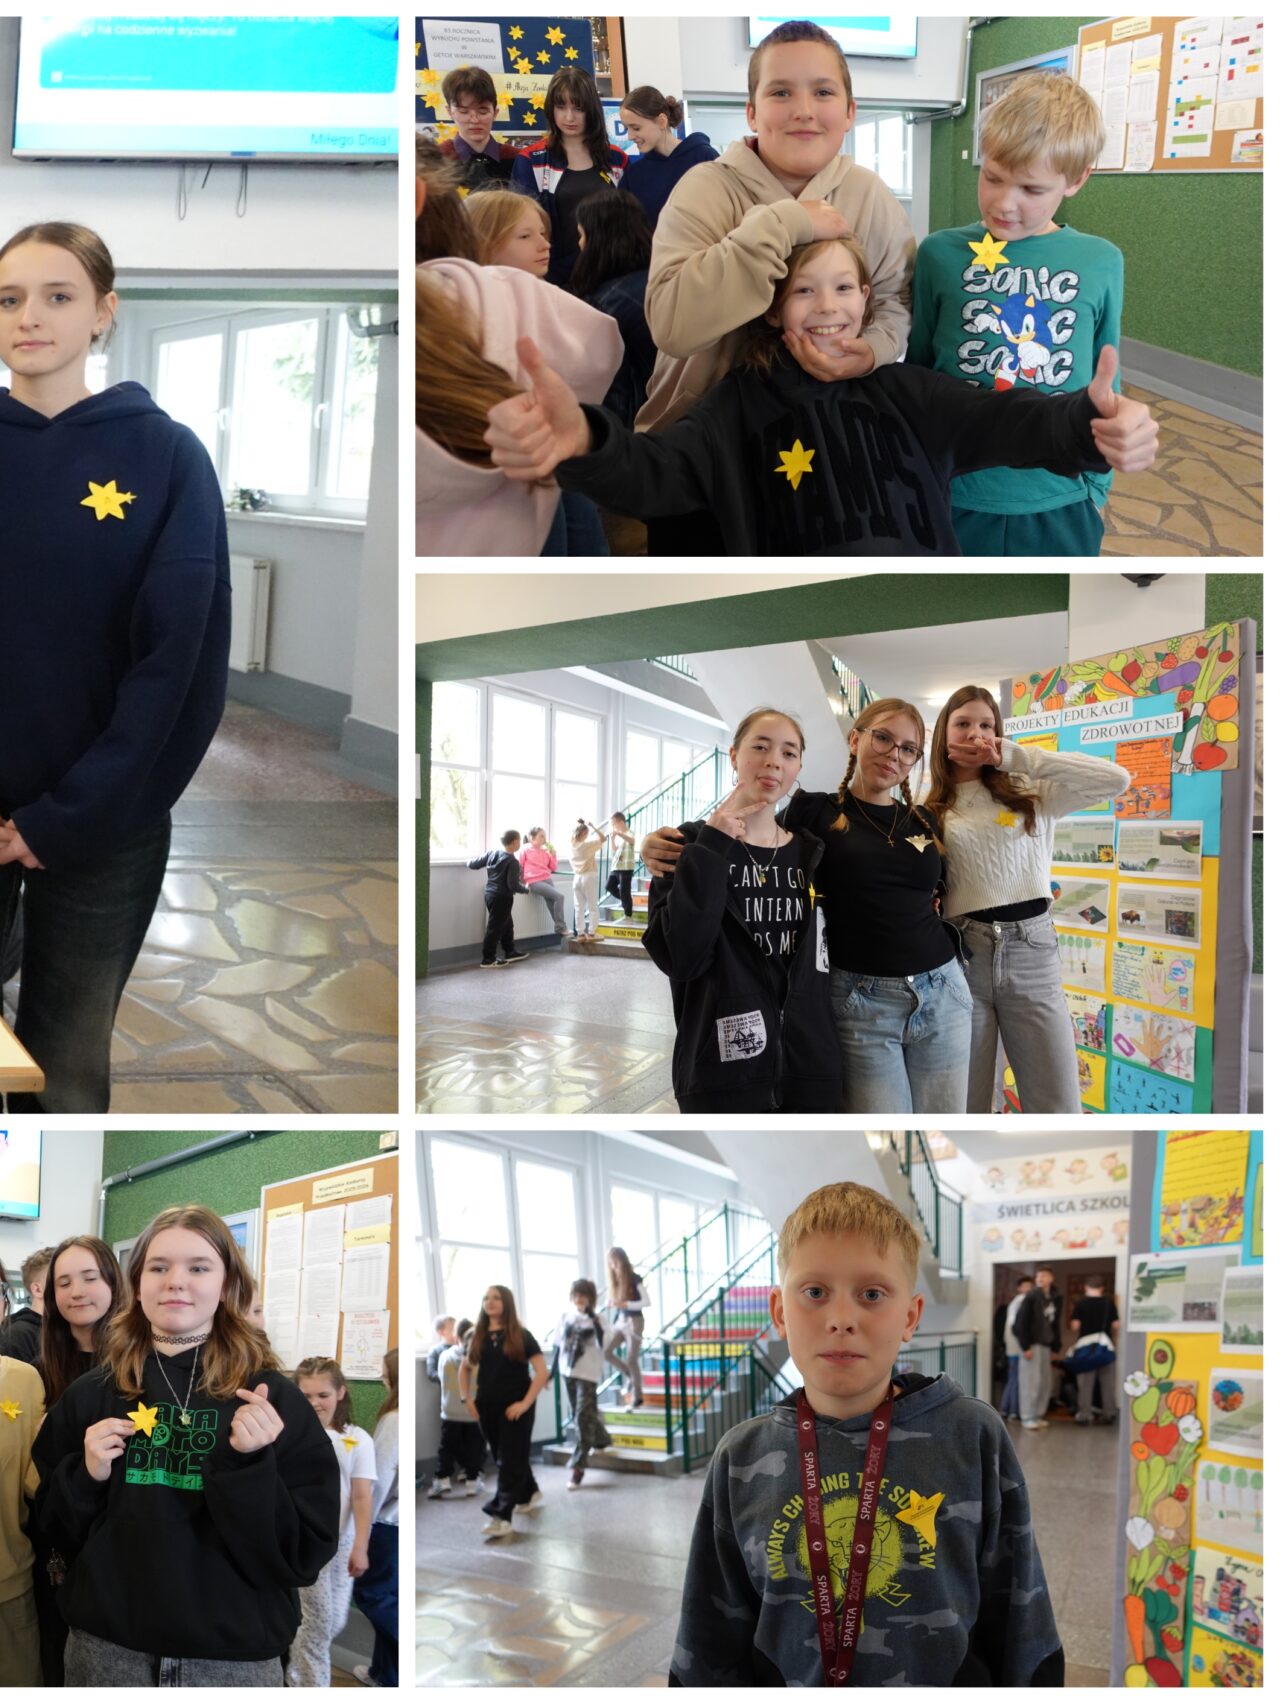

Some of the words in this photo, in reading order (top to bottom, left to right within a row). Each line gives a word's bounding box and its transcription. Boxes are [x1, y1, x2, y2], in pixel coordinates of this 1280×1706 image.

[1004, 714, 1061, 733] PROJEKTY
[1063, 701, 1130, 722] EDUKACJI
[745, 896, 804, 922] INTERN
[997, 1199, 1076, 1219] ŚWIETLICA
[1080, 1196, 1130, 1213] SZKOL
[804, 1451, 817, 1490] SPARTA
[860, 1480, 876, 1521] SPARTA
[767, 1519, 791, 1580] ALWAYS
[782, 1472, 850, 1519] CHING
[817, 1575, 831, 1616] SPARTA
[842, 1607, 858, 1647] SPARTA
